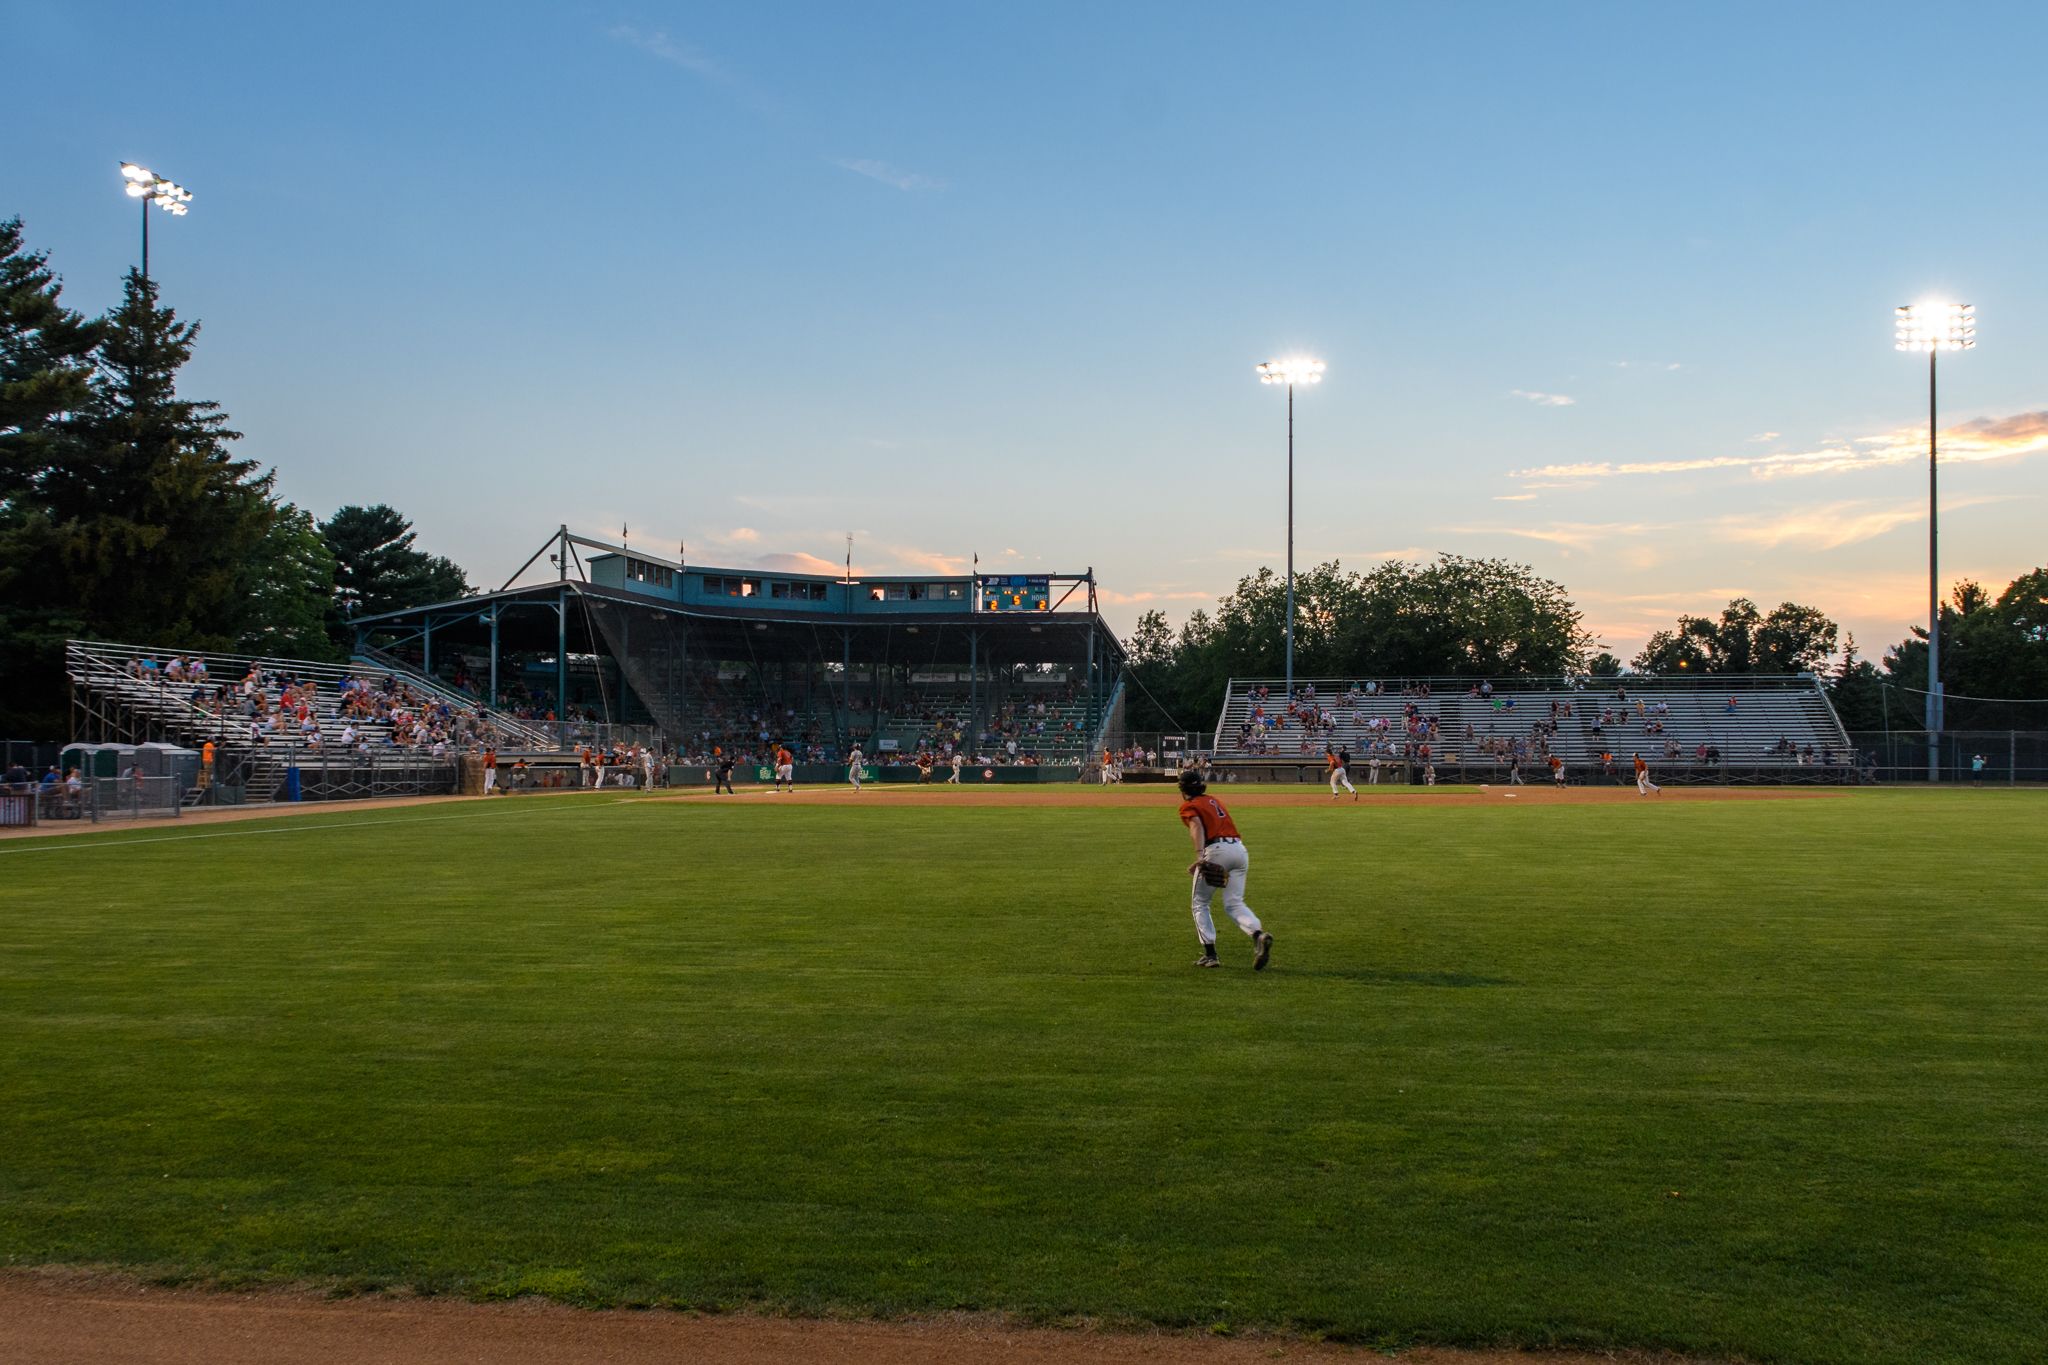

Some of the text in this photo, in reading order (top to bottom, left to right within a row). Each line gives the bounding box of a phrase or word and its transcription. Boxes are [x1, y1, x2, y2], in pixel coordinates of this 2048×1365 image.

[991, 600, 998, 611] 2
[1013, 595, 1021, 605] 5
[1039, 600, 1046, 611] 2
[1209, 799, 1226, 818] 1
